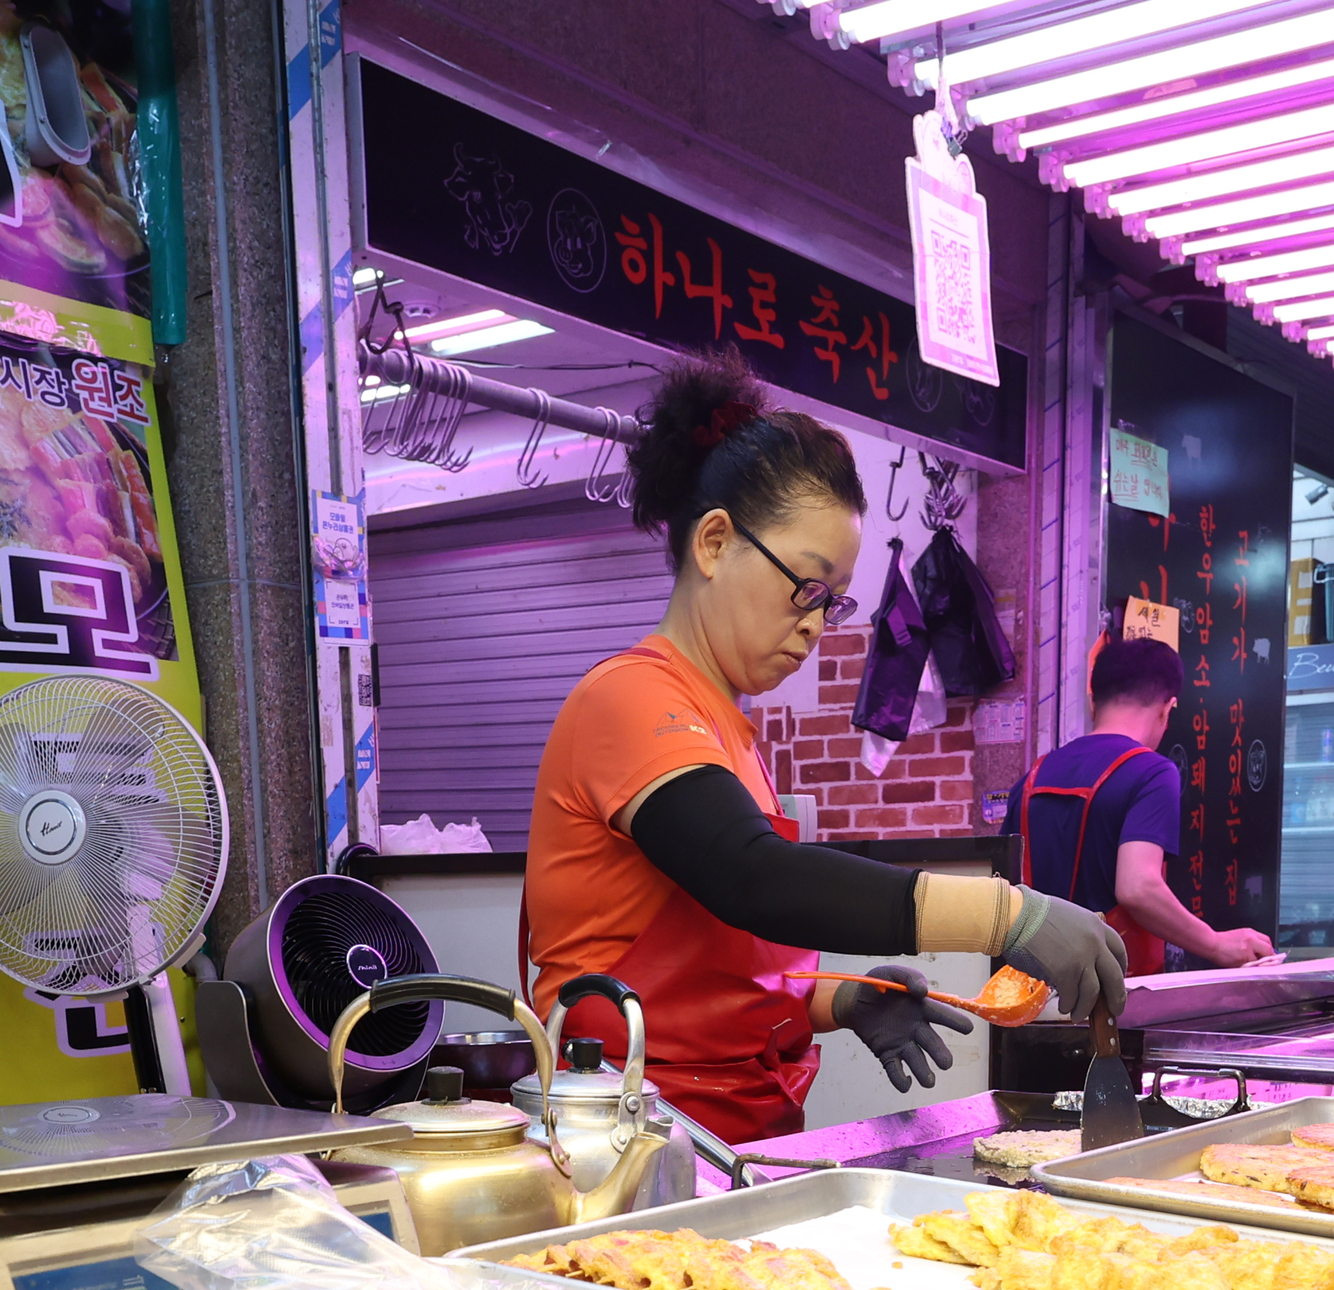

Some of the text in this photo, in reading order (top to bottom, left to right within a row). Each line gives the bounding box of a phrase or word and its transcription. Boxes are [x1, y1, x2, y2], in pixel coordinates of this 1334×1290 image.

[69, 359, 152, 427] 원조
[616, 213, 899, 402] 하나로 축산
[1224, 530, 1250, 907] 고기가 맛있는 집
